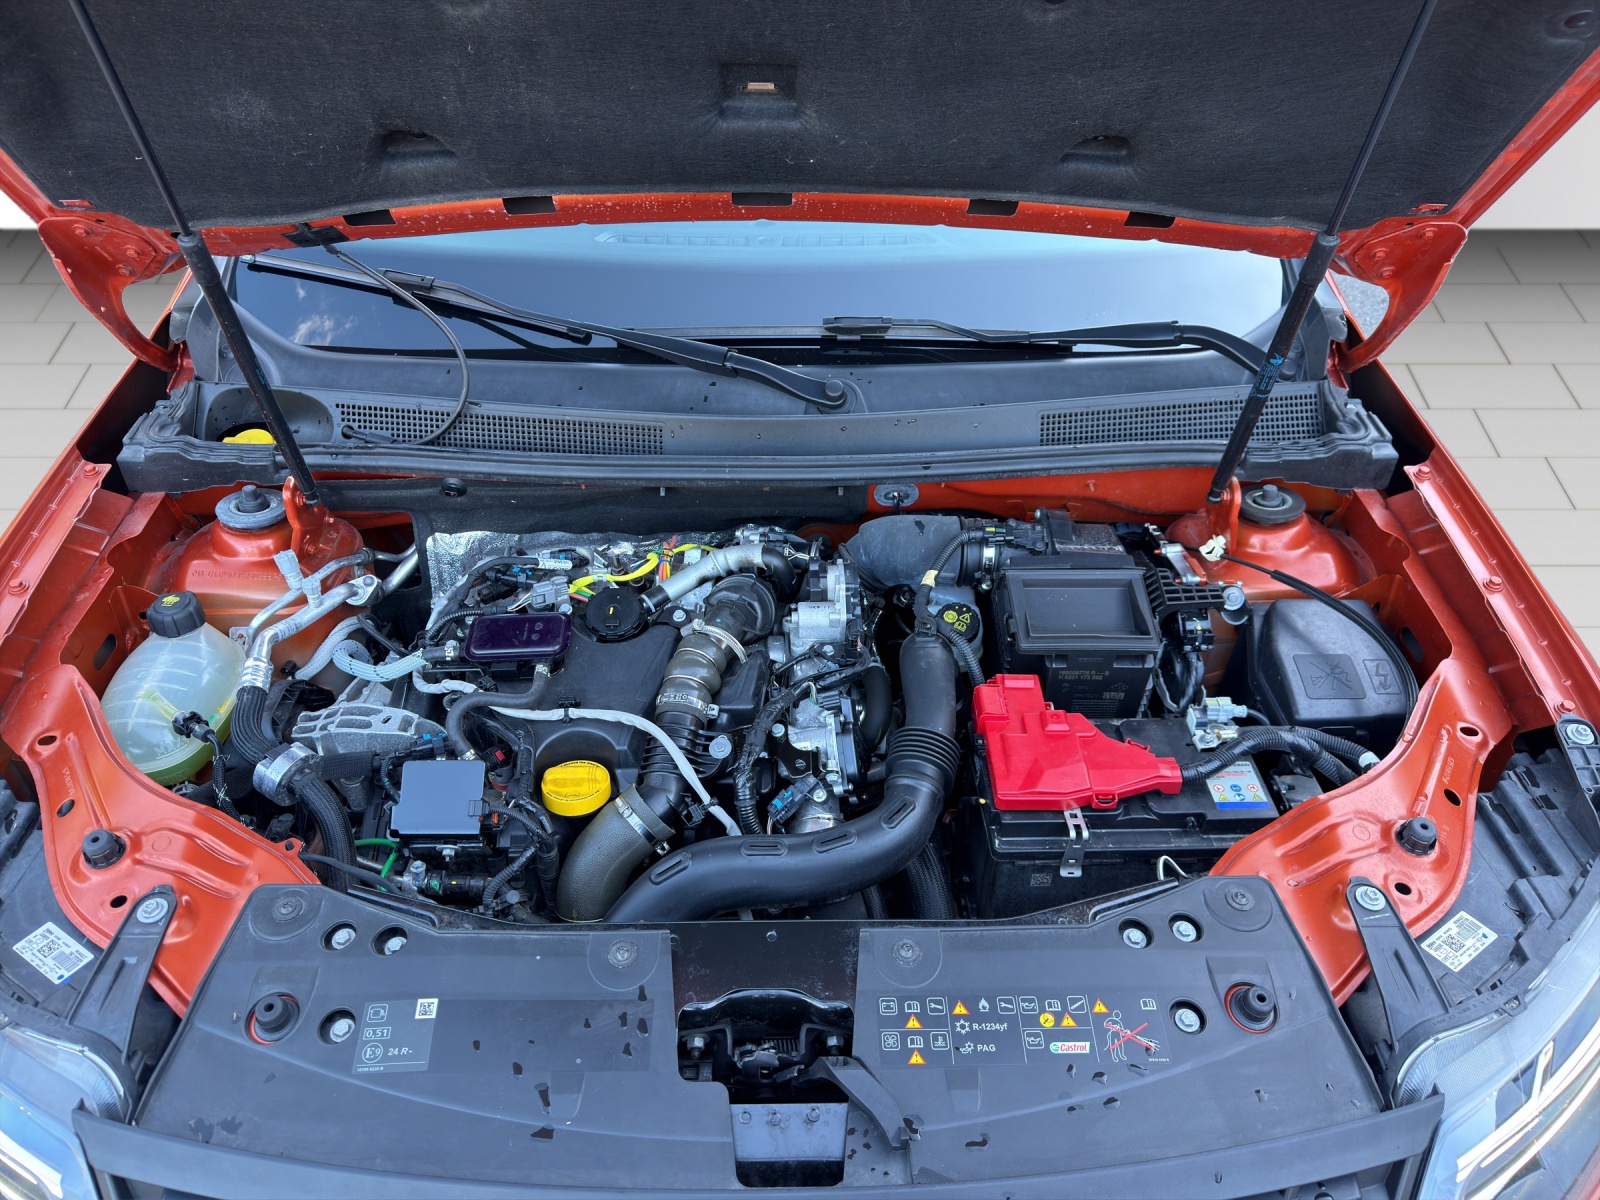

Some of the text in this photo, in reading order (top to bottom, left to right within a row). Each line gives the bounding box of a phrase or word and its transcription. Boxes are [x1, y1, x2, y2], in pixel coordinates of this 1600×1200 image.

[973, 1023, 1008, 1032] R-1234yf
[977, 1044, 997, 1052] PAG
[1060, 1043, 1088, 1052] Castrol
